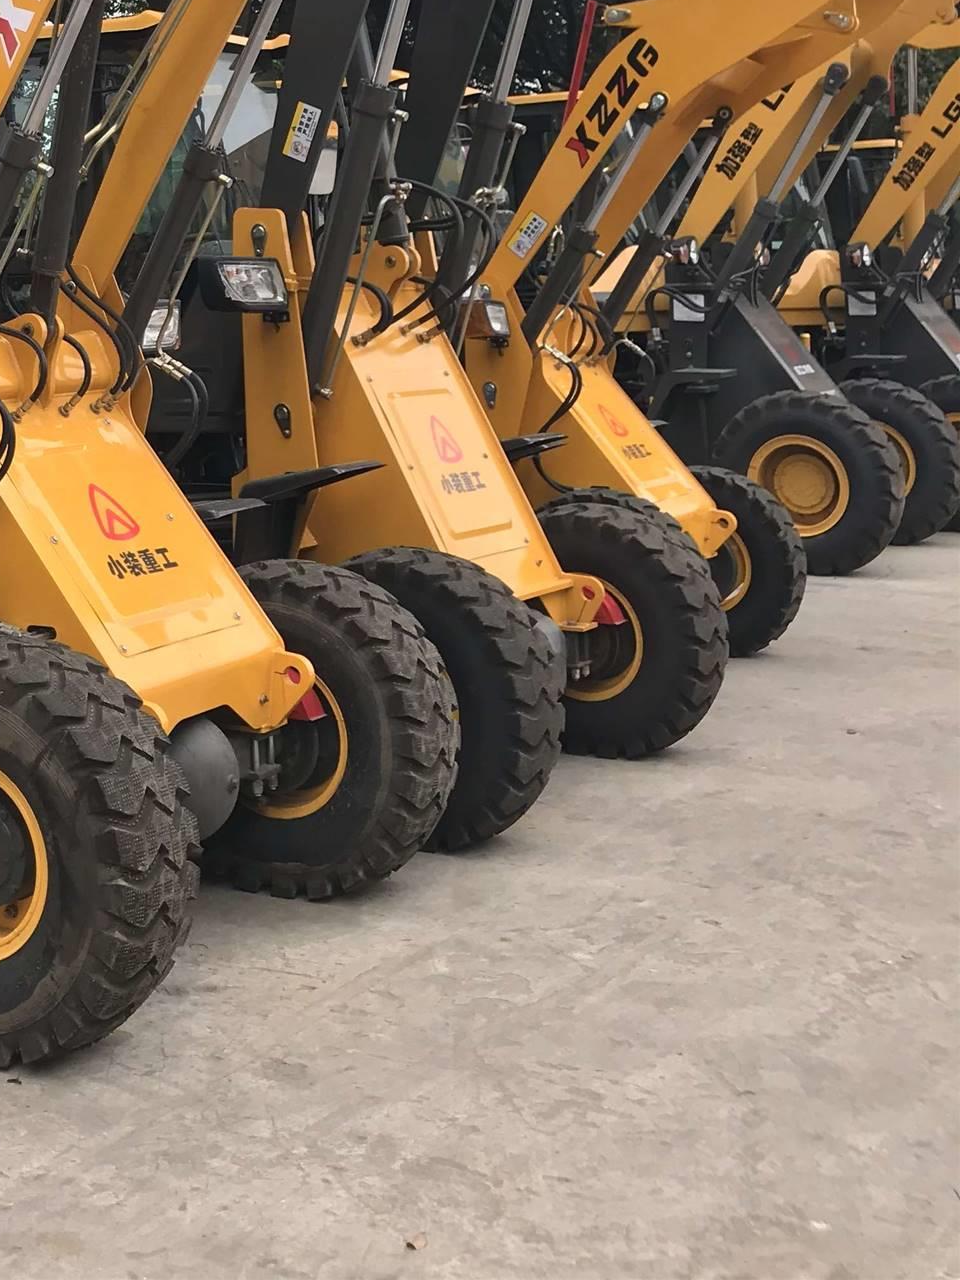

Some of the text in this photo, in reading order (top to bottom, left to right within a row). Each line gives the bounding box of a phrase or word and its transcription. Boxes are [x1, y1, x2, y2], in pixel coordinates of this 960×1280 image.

[565, 38, 659, 169] XZZG
[715, 121, 763, 181] 加强型
[107, 547, 179, 579] 小装重工
